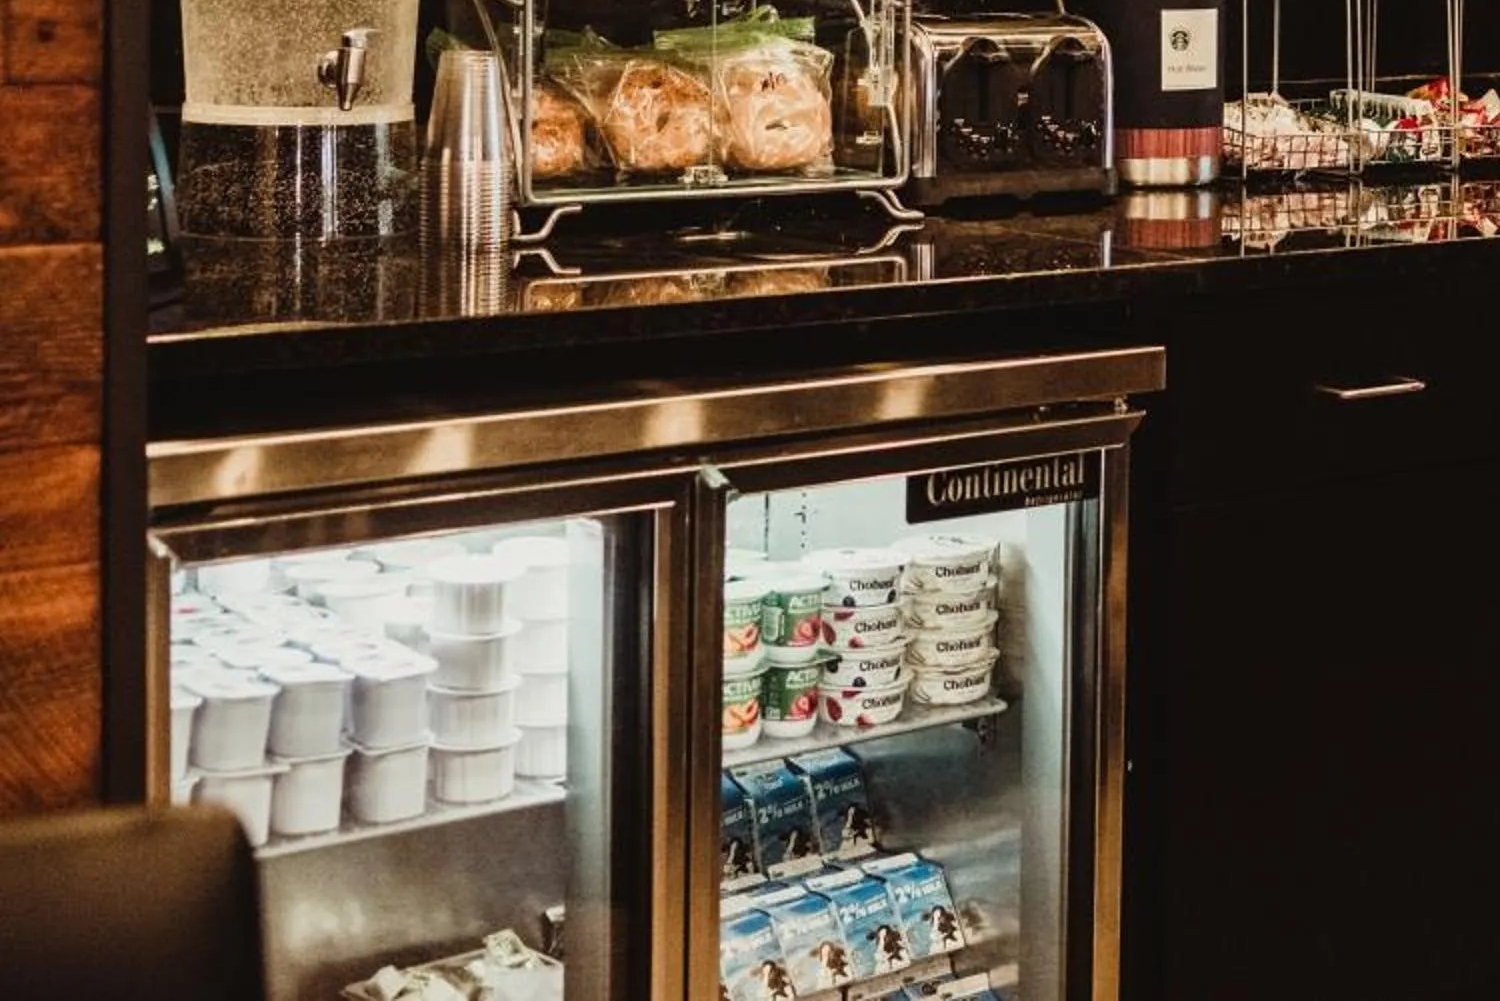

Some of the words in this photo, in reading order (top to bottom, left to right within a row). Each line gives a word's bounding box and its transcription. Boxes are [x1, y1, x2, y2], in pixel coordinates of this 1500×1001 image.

[927, 454, 1085, 505] Continental
[788, 595, 818, 610] ACTI
[786, 670, 818, 686] ACTI
